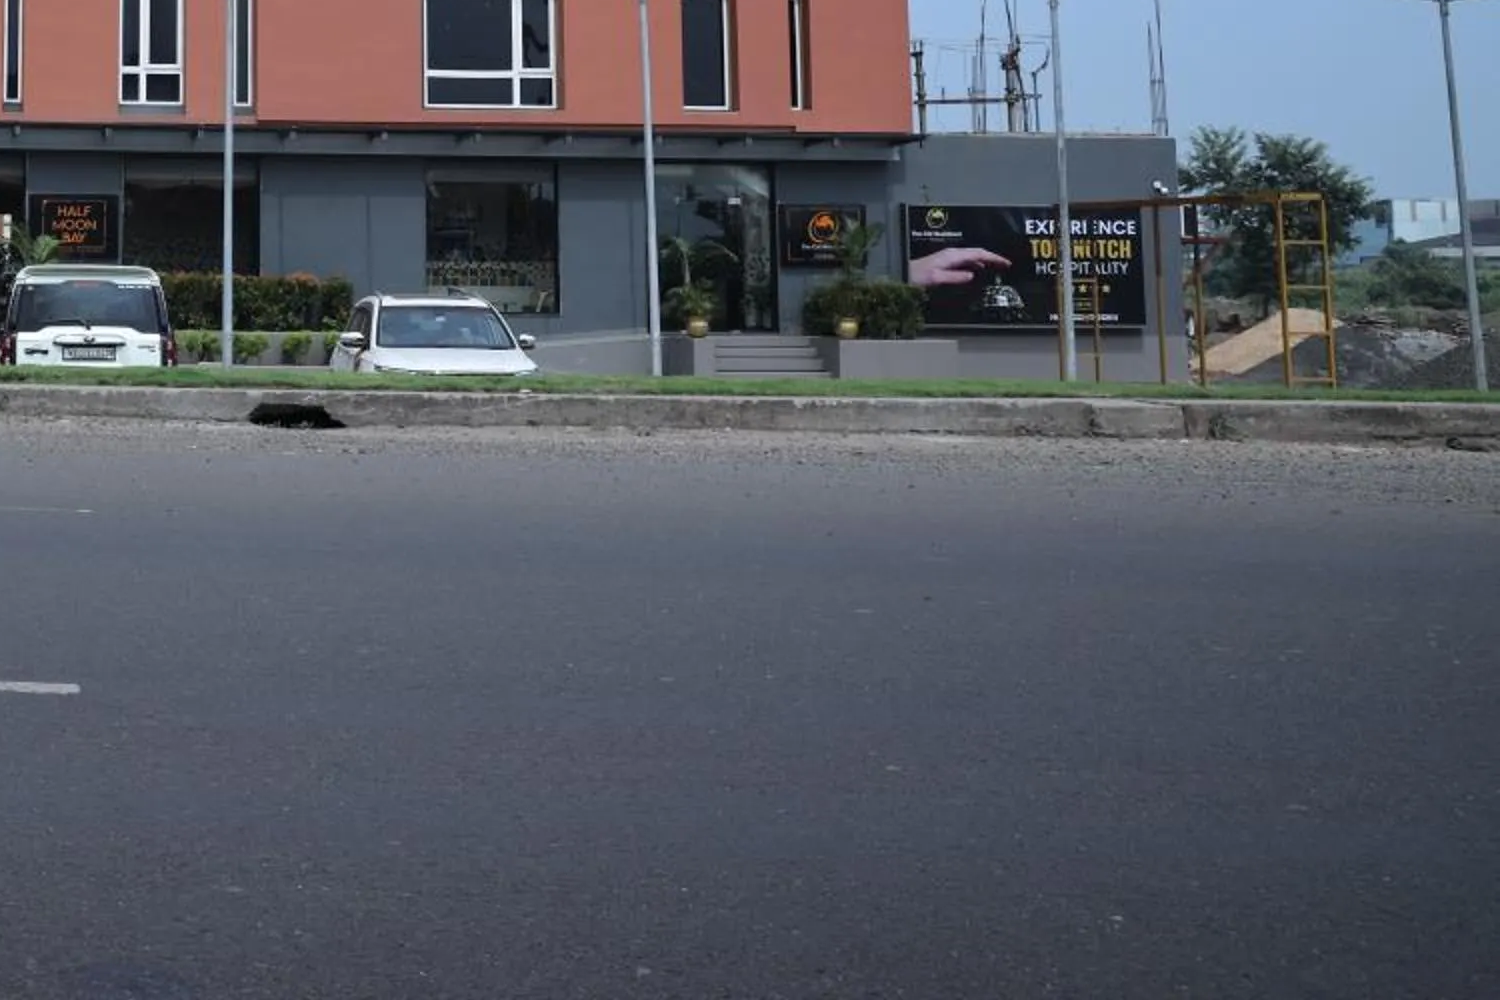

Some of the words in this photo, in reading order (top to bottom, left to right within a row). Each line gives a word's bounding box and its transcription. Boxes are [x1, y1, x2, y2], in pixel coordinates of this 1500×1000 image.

[57, 205, 92, 217] HALF
[52, 219, 97, 231] MOON
[1025, 219, 1137, 236] EXRINCE
